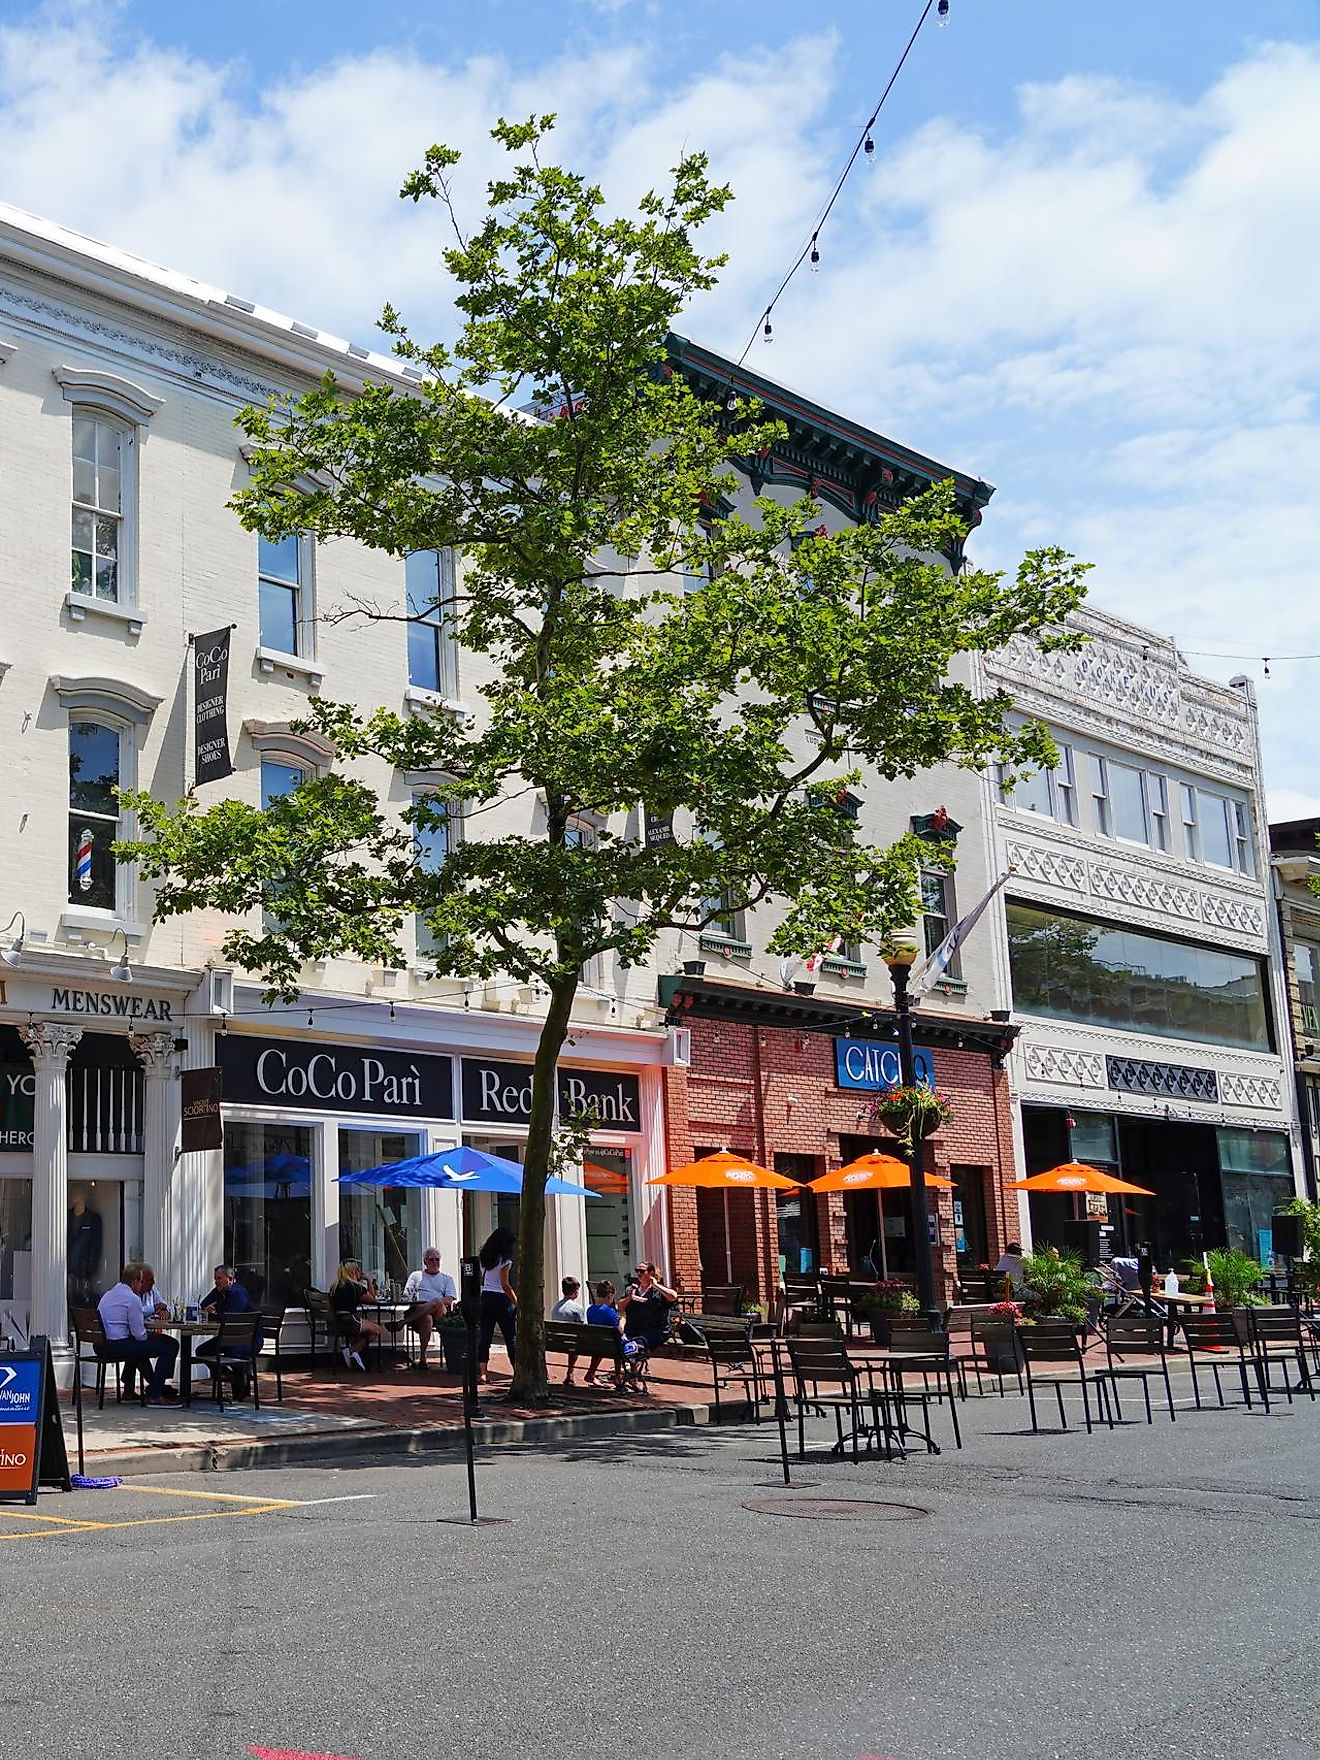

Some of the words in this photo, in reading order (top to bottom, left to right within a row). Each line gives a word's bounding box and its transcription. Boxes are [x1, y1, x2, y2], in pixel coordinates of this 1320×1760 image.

[196, 646, 228, 669] CoCo
[197, 705, 225, 725] CLOTHING
[51, 988, 173, 1022] MENSWEAR
[257, 1049, 356, 1100] CoCo
[846, 1046, 903, 1085] CATC
[6, 1074, 36, 1096] YO
[566, 1078, 636, 1123] Bank
[0, 1130, 35, 1145] HERO
